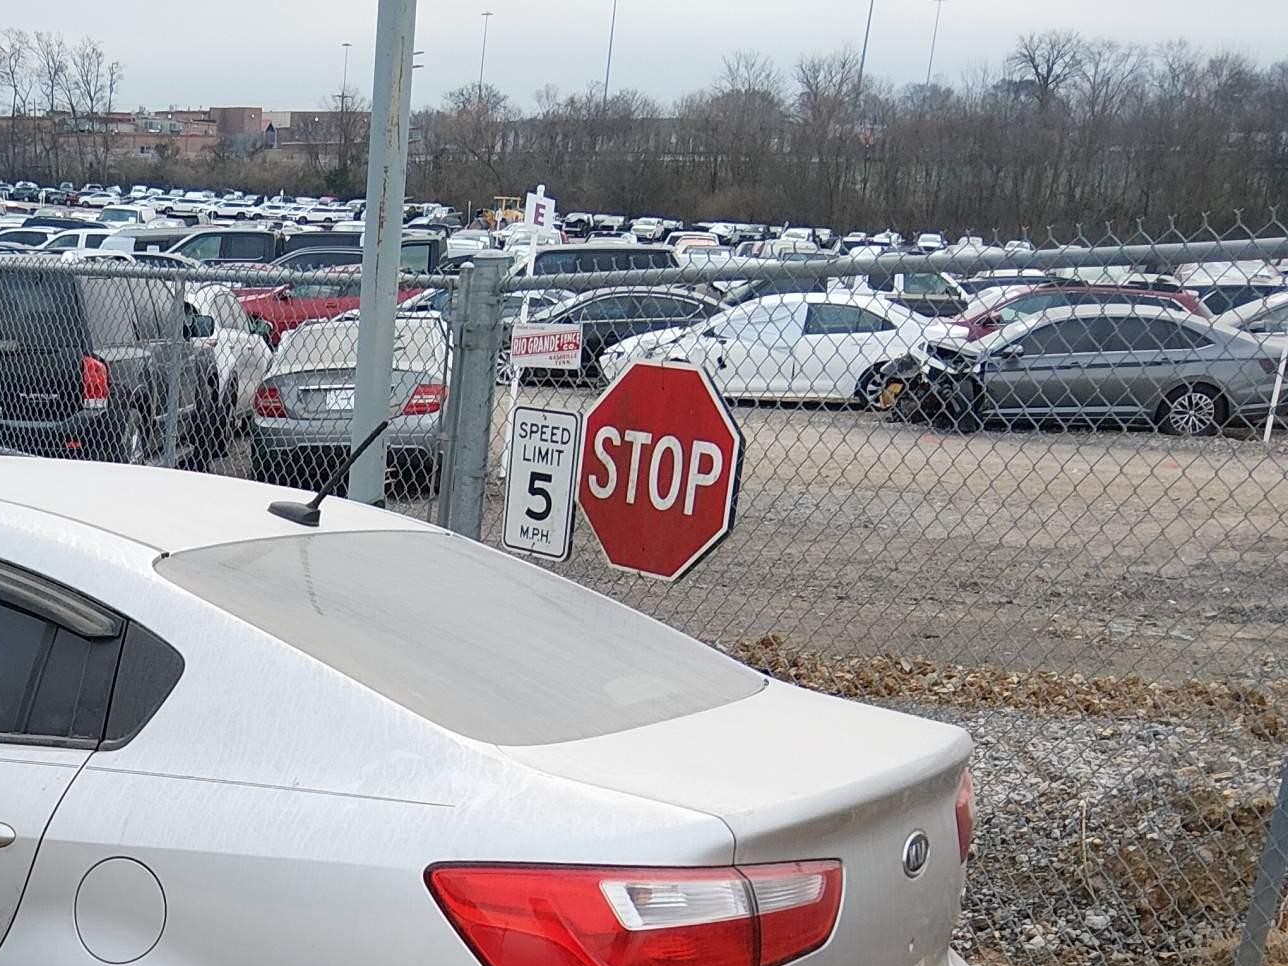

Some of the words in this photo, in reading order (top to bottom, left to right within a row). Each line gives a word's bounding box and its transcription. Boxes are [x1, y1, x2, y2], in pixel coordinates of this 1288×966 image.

[533, 202, 547, 227] E
[513, 338, 528, 355] RIO
[527, 335, 559, 354] GRANDE
[562, 343, 578, 351] CO.
[518, 421, 571, 445] SPEED
[522, 443, 564, 467] LIMIT
[588, 425, 724, 516] STOP
[525, 471, 553, 521] 5
